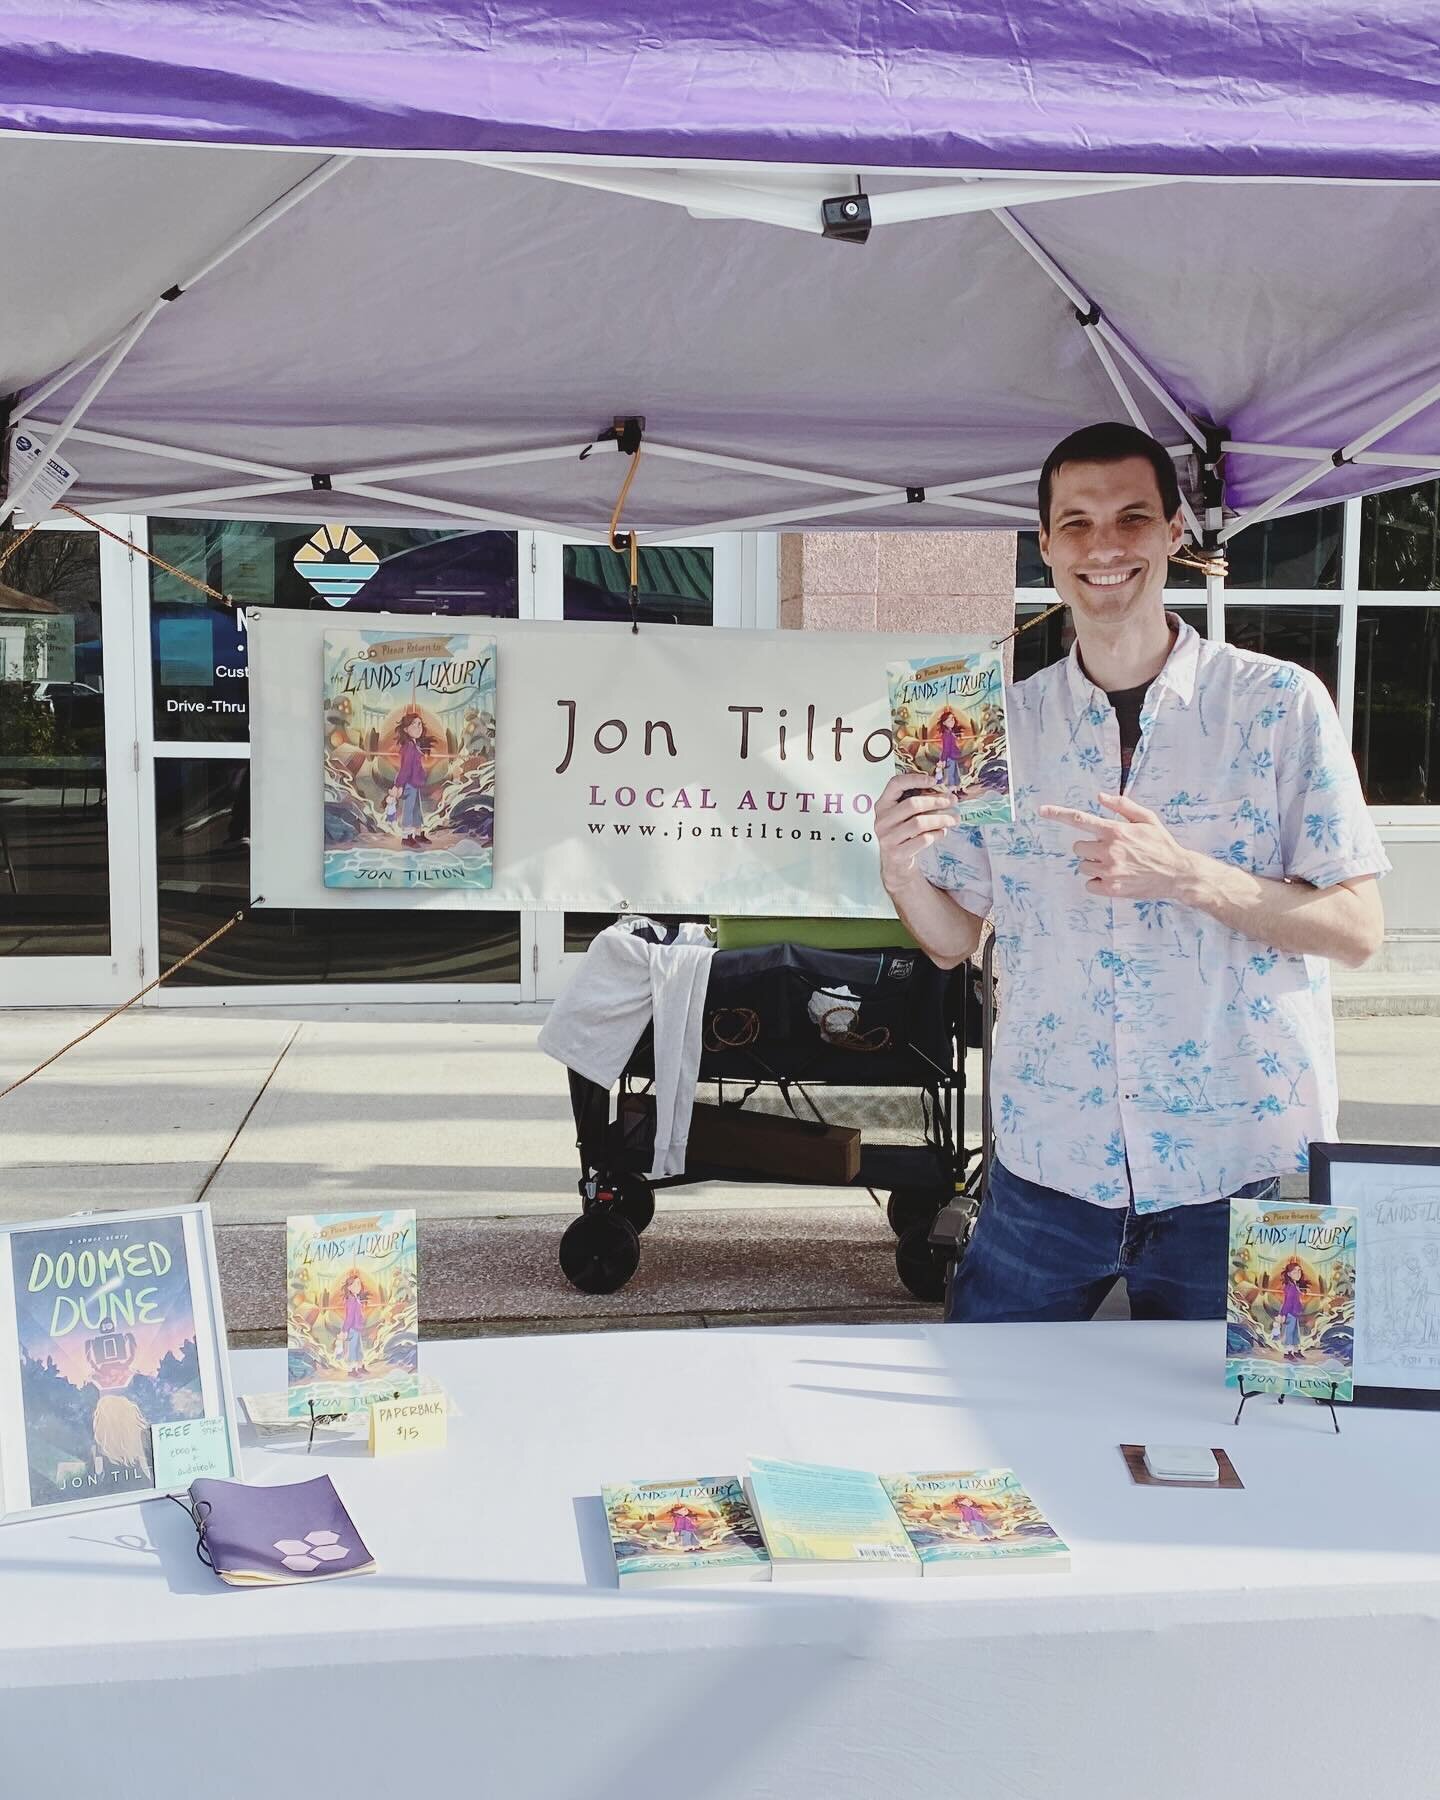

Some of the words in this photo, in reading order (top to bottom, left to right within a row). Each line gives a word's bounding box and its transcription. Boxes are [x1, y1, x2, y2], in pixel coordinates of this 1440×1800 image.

[215, 666, 249, 678] Cust
[343, 663, 402, 695] LANDS
[405, 667, 415, 681] of
[416, 657, 491, 691] LUXURY
[902, 681, 938, 704] LANDS
[949, 668, 995, 694] LUXURY
[167, 699, 246, 713] Drive-Thru
[555, 700, 677, 774] Jon
[728, 704, 893, 763] Tilto
[589, 785, 717, 809] LOCAL
[737, 791, 873, 815] AUTHO
[588, 821, 873, 843] www.jontilton.co
[354, 869, 393, 880] JON
[403, 868, 465, 880] TILTON
[303, 1240, 345, 1264] LANDS
[357, 1229, 409, 1256] LUXURY
[1245, 1226, 1288, 1246] LANDS
[1298, 1225, 1352, 1248] LUXURY
[28, 1241, 172, 1292] DOOMED
[50, 1287, 165, 1337] DUNE
[1248, 1374, 1276, 1385] JON
[1283, 1379, 1332, 1389] TILTON
[379, 1402, 442, 1422] PAPERBACK
[159, 1424, 191, 1440] FREE
[397, 1427, 419, 1440] $15
[60, 1474, 98, 1490] JON
[904, 1481, 946, 1493] LANDS
[959, 1476, 1010, 1490] LUXURY
[624, 1490, 666, 1503] LANDS
[680, 1484, 734, 1498] LUXURY
